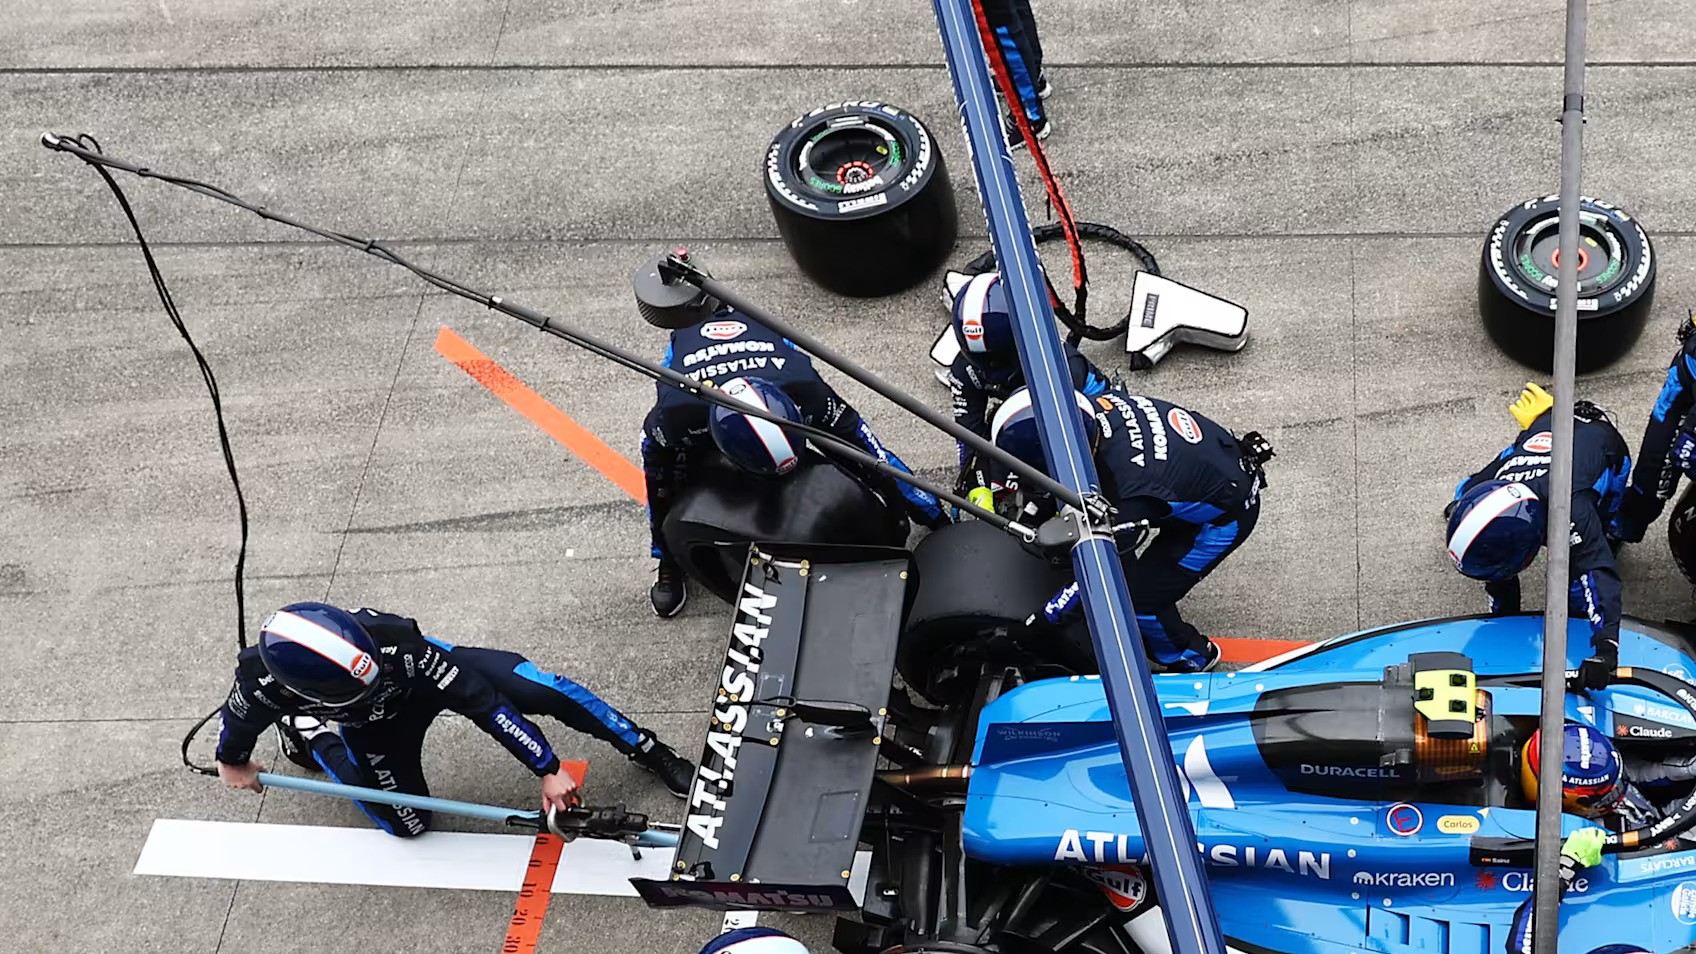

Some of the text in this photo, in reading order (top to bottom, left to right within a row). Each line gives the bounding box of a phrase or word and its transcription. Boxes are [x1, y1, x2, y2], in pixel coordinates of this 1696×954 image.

[1520, 254, 1544, 281] SCORES
[963, 325, 983, 336] Gulf
[683, 340, 775, 367] KOMATSU
[685, 356, 768, 382] ATLASSIA
[1500, 468, 1548, 482] ATLAS
[353, 653, 371, 677] Gulf
[686, 582, 778, 850] ATLASSIAN
[1647, 705, 1695, 725] BARCLAY
[495, 712, 542, 759] KOMATSU
[996, 728, 1062, 738] WILKINSON
[1629, 725, 1673, 739] Claude
[1300, 763, 1400, 779] DURACELL
[1568, 774, 1610, 787] ATLASSIAN
[376, 766, 425, 836] ATLSIAN
[1392, 807, 1417, 833] E
[1443, 819, 1473, 830] Carlos
[1053, 828, 1332, 880] ATLSIAN
[1640, 854, 1695, 873] BARCLAYS
[520, 880, 537, 899] 10
[1375, 871, 1455, 888] kraken
[1501, 871, 1590, 893] Clae
[659, 885, 833, 908] KOMATSU
[511, 907, 528, 926] 20
[502, 934, 521, 954] 30
